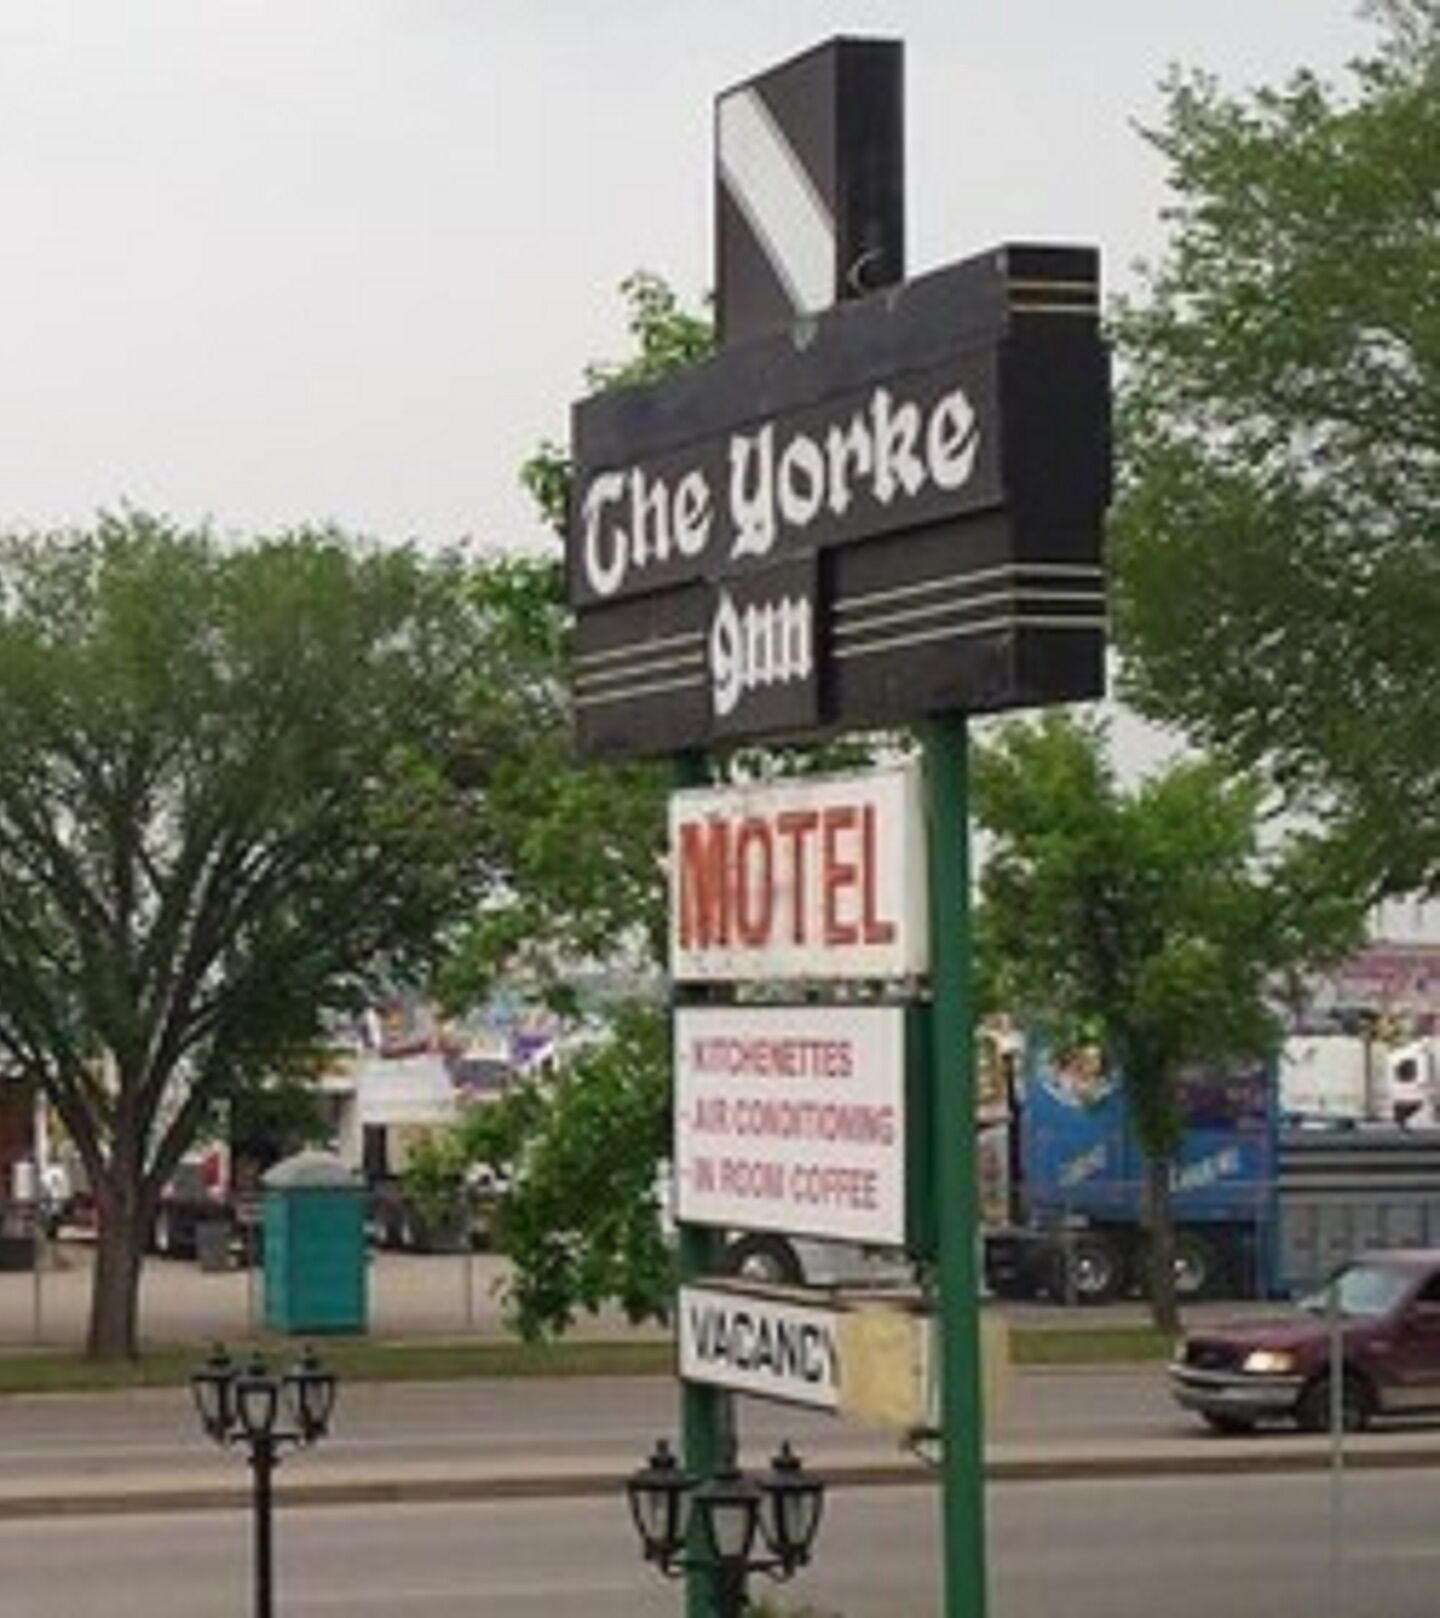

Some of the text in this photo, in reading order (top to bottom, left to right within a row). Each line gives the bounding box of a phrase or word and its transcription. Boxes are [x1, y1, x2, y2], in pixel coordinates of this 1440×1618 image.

[582, 388, 980, 596] The Yorke
[709, 592, 813, 716] Inn
[678, 804, 895, 951] MOTEL
[692, 1037, 852, 1078] KITCHENETTES
[692, 1099, 894, 1146] AIR CONDITIONING
[720, 1159, 785, 1199] ROOM
[790, 1164, 878, 1210] COFFEE
